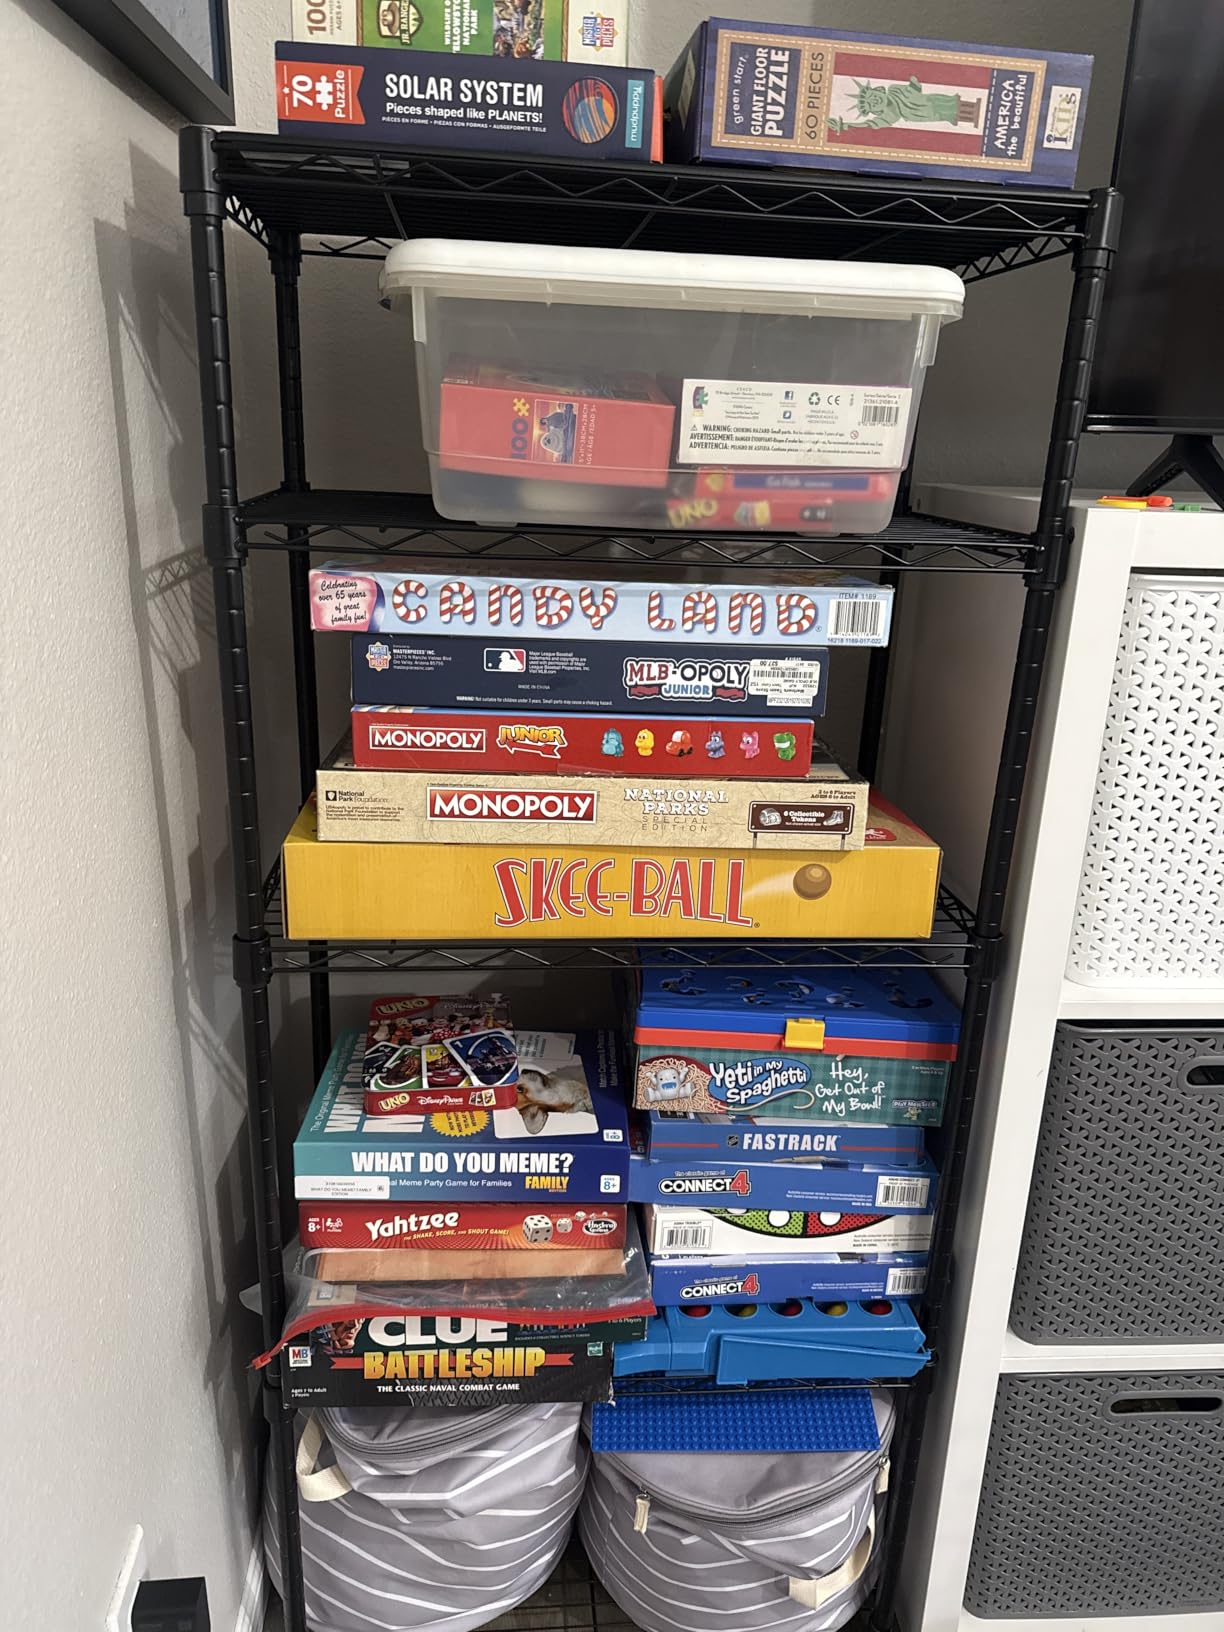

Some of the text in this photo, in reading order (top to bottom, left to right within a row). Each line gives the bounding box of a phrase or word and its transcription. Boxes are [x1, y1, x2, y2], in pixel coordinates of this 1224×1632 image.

[401, 32, 410, 43] JR.
[584, 18, 596, 45] MASTER
[602, 19, 614, 46] PIECES
[292, 75, 313, 107] 70
[334, 70, 346, 118] Puzzle
[385, 73, 543, 107] SOLAR SYSTEM
[751, 47, 769, 135] GIANT FLOOR
[764, 49, 790, 136] PUZZLE
[804, 52, 824, 140] 60 PIECES
[386, 102, 543, 123] Pieces shaped like PLANETS!
[732, 89, 744, 124] green
[994, 80, 1015, 149] AMERICA
[1007, 74, 1028, 156] the beautiful
[511, 418, 528, 459] 100
[703, 424, 732, 434] WARNING:
[689, 442, 729, 450] ADVERTENCIA:
[668, 498, 718, 529] UNO
[321, 579, 357, 591] Celebrating
[336, 590, 345, 600] 65
[348, 592, 366, 601] years
[839, 592, 859, 600] ITEM#
[331, 610, 367, 625] family fun!
[335, 602, 360, 613] of great
[392, 580, 818, 635] CANDY LAND
[664, 684, 711, 696] JUNIOR
[375, 726, 565, 749] MONOPOLY JUNIOR
[434, 793, 592, 818] MONOPOLY
[624, 788, 729, 803] NATIONAL
[642, 802, 709, 816] PARKS
[642, 816, 708, 824] SPECIAL
[642, 824, 708, 832] EDITION
[493, 857, 753, 928] SKEE-BALL
[376, 999, 429, 1015] UNO
[709, 1060, 783, 1089] Yeti in My
[830, 1061, 869, 1083] Hey,
[726, 1066, 807, 1104] Spaghetti
[815, 1081, 885, 1098] Get Out of
[315, 1101, 330, 1121] Original
[323, 1084, 364, 1133] WHAT
[379, 1093, 410, 1112] UNO
[822, 1095, 882, 1116] My Bowl!
[310, 1120, 322, 1133] The
[742, 1133, 838, 1151] FASTRACK
[352, 1152, 573, 1173] WHAT DO YOU MEME?
[424, 1180, 444, 1189] Party
[469, 1179, 480, 1187] for
[525, 1175, 569, 1189] FAMILY
[603, 1181, 617, 1190] 8+
[660, 1170, 750, 1195] CONNECT 4
[308, 1222, 321, 1232] 8+
[365, 1211, 460, 1241] Yahtzee
[413, 1232, 434, 1240] SHAKE,
[682, 1274, 758, 1298] CONNECT 4
[368, 1315, 508, 1347] CLUE
[292, 1348, 309, 1359] MB
[364, 1347, 546, 1380] BATTLESHIP
